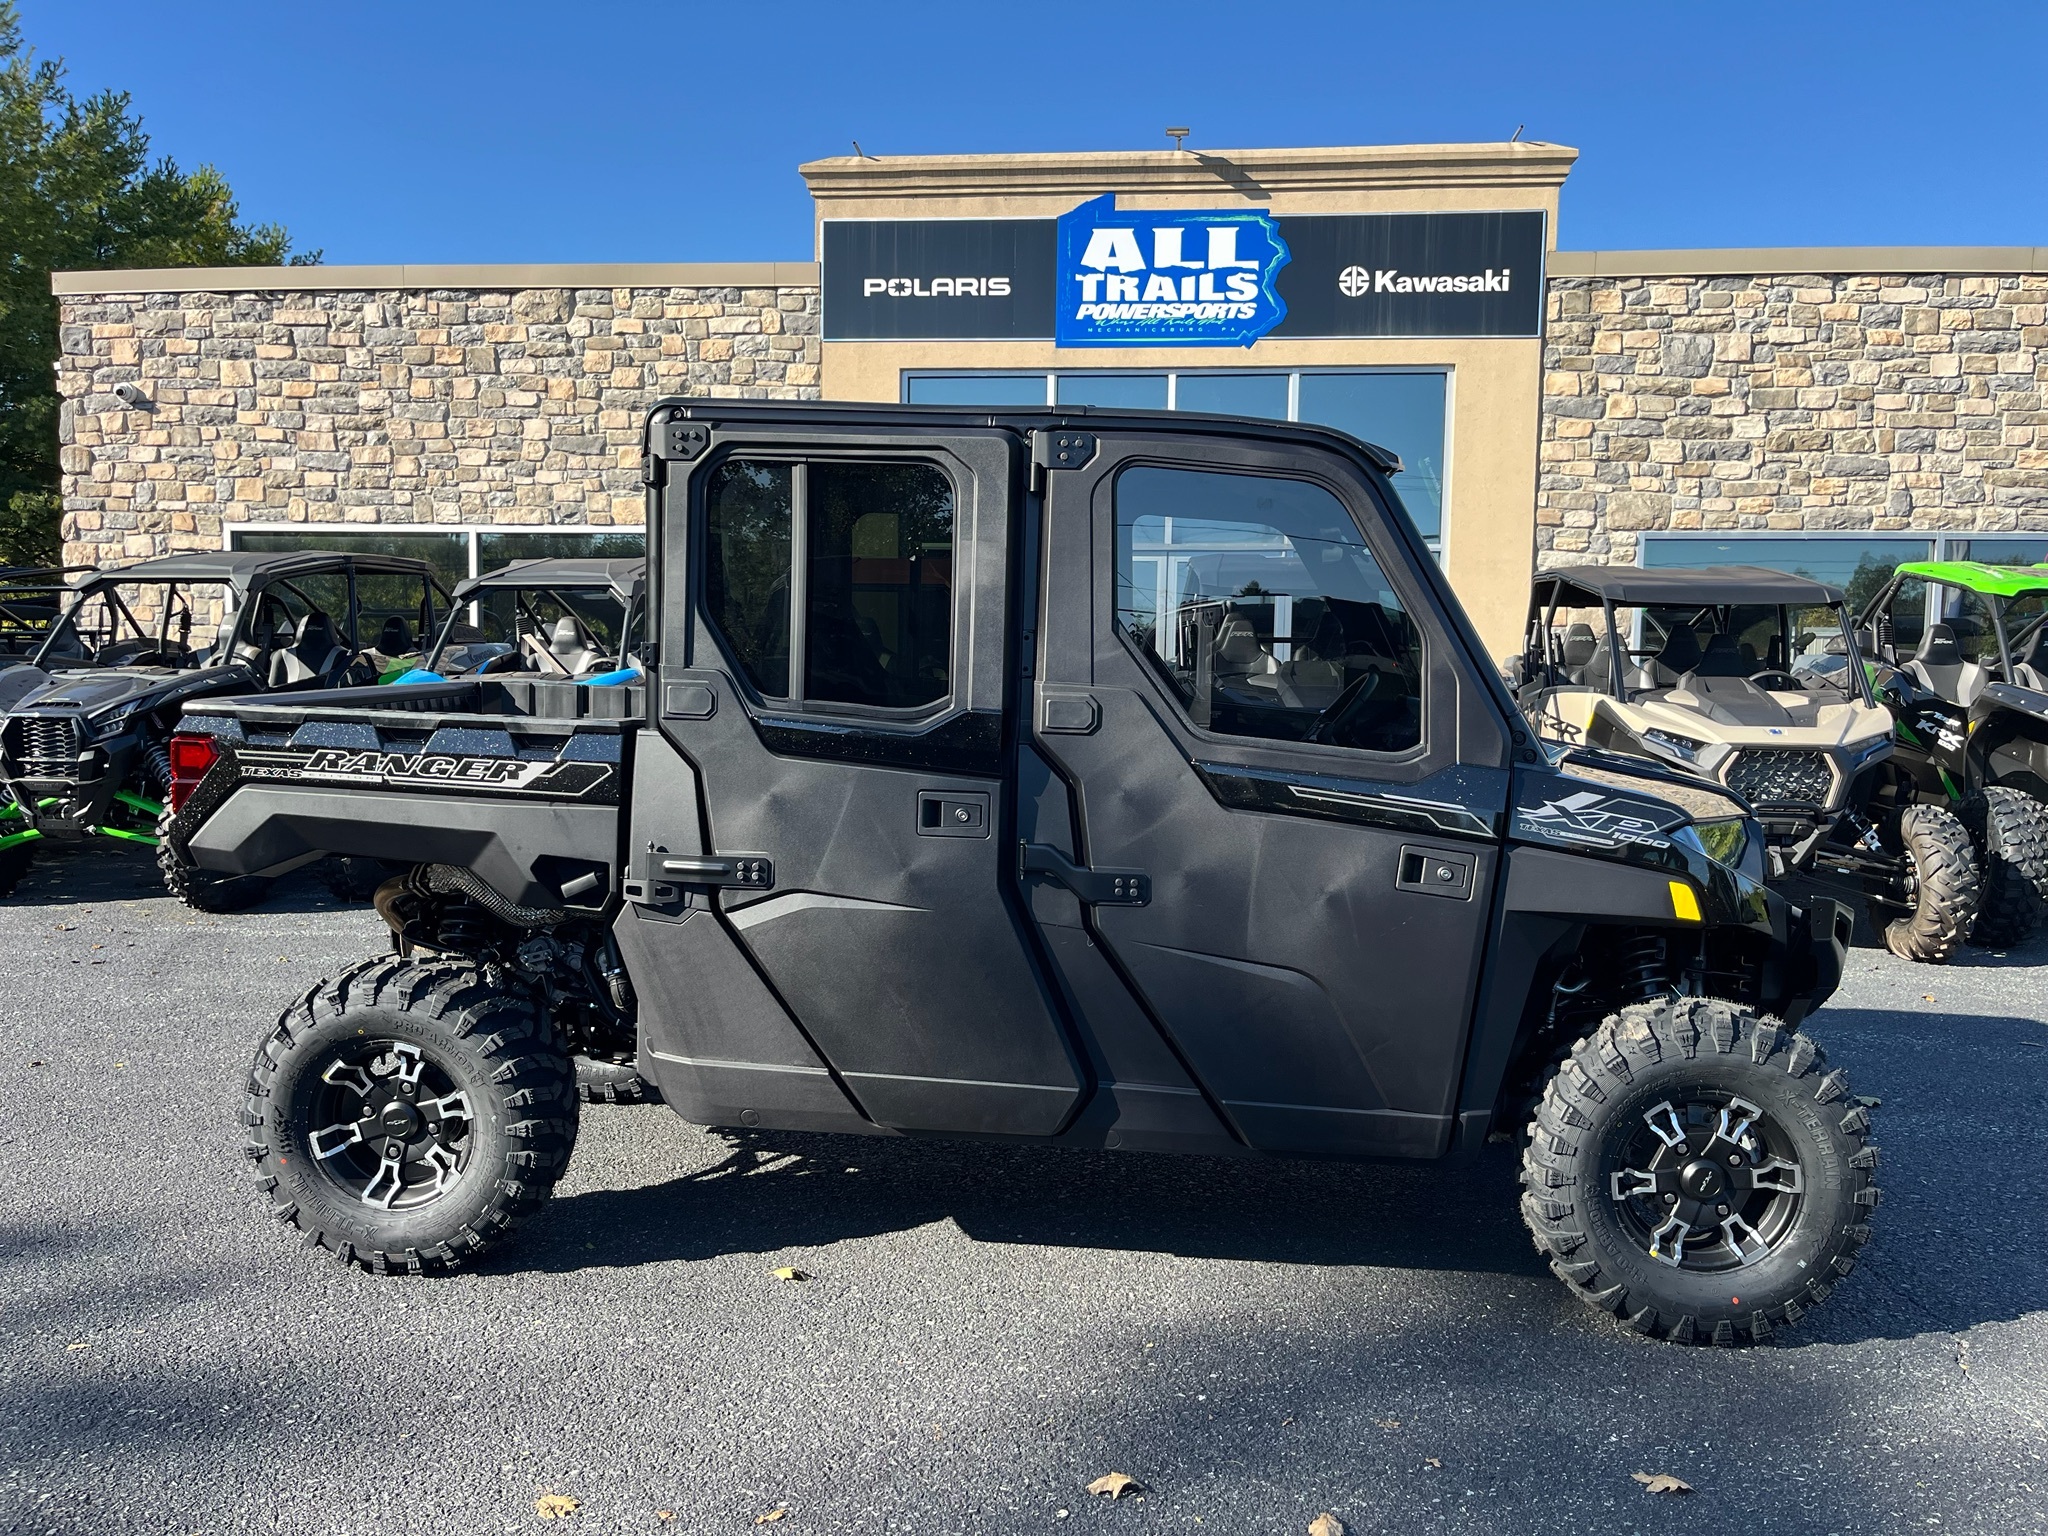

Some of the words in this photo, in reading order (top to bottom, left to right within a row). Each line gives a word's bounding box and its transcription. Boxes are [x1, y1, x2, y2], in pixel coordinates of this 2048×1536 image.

[1080, 226, 1260, 273] ALL
[863, 277, 1010, 297] POLARIS
[1074, 272, 1259, 302] TRAILS
[1374, 269, 1509, 293] Kawasaki
[1075, 302, 1257, 320] POWERSPORTS
[240, 765, 304, 779] TEXAS
[302, 748, 528, 781] RANGER
[1517, 791, 1661, 834] XP
[1611, 831, 1671, 849] 1000
[1774, 1087, 1842, 1191] X-TERRAIN
[287, 1171, 379, 1242] X-TERRAIN
